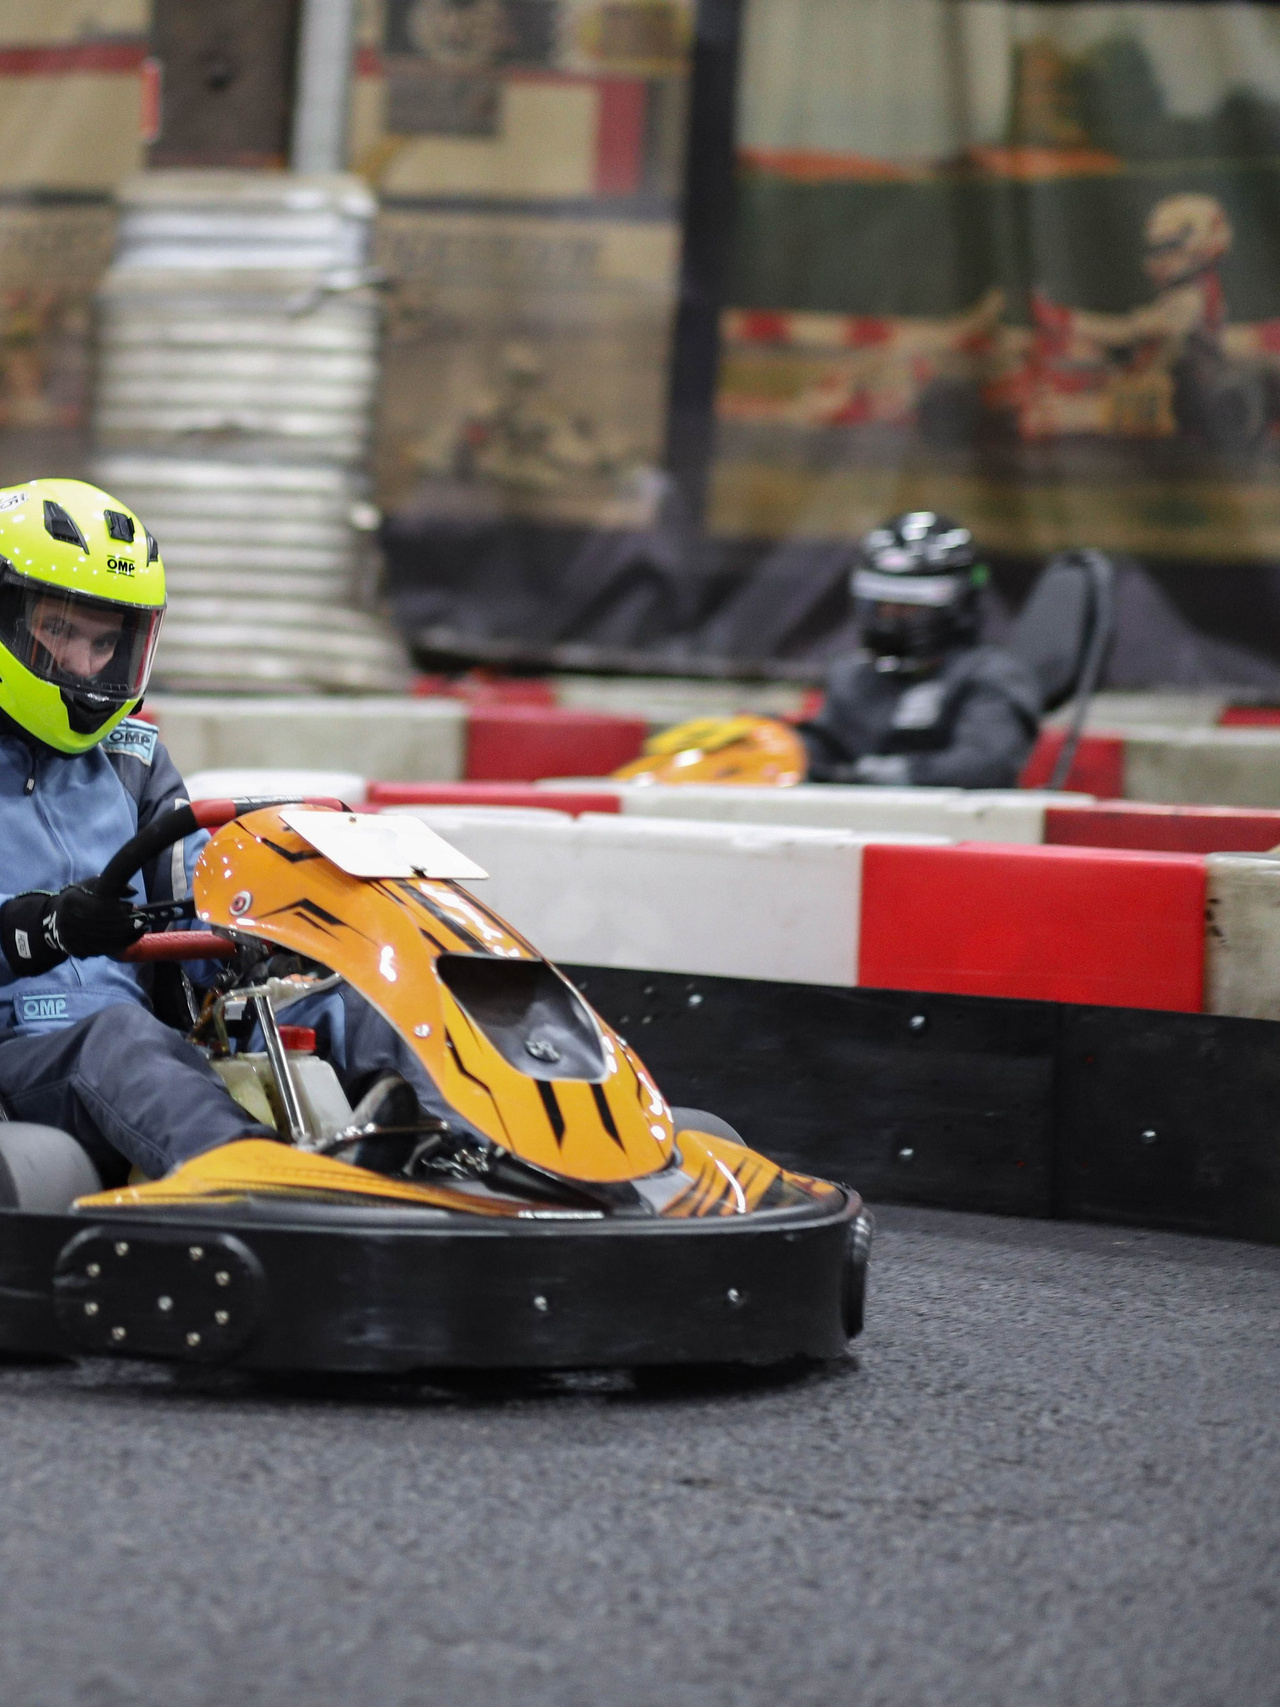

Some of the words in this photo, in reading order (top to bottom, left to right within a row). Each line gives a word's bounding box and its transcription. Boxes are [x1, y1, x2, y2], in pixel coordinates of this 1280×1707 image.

[106, 558, 135, 573] OMP
[110, 730, 151, 744] OMP
[23, 999, 67, 1017] OMP
